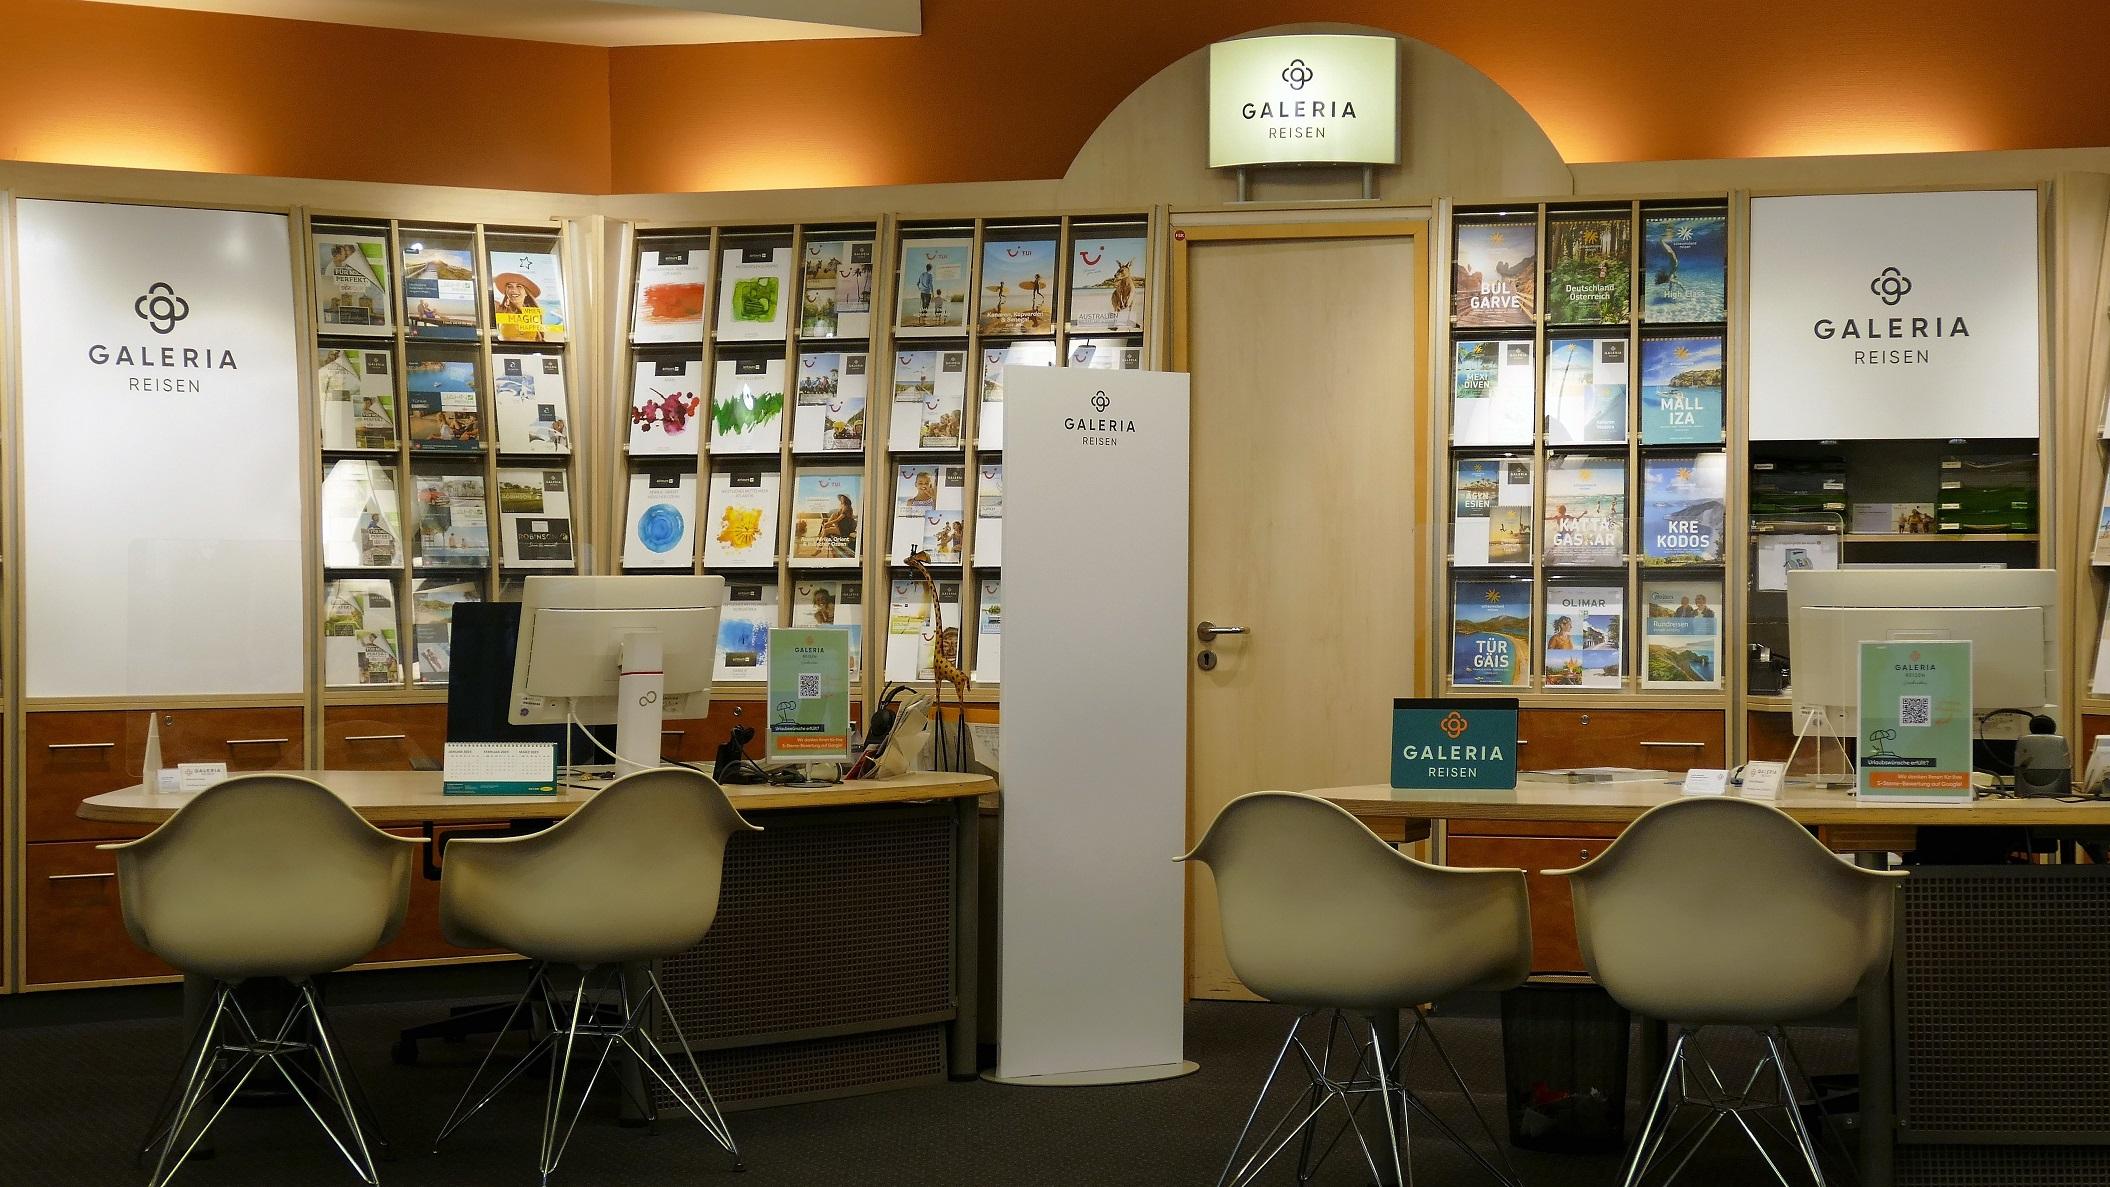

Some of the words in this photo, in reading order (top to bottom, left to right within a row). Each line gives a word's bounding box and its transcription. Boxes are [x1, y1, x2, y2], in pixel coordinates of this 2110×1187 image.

[1242, 100, 1357, 120] GALERIA
[1269, 126, 1326, 139] REISEN
[1481, 281, 1511, 295] BUL
[1565, 284, 1615, 293] Deutschland
[1663, 290, 1681, 300] High
[1470, 296, 1521, 309] GARVE
[1079, 312, 1119, 320] AUSTRALIEN
[1813, 316, 1970, 340] GALERIA
[88, 344, 238, 370] GALERIA
[1854, 350, 1929, 365] REISEN
[1466, 373, 1488, 381] MEXI
[129, 377, 200, 393] REISEN
[1464, 381, 1490, 389] DIVEN
[1661, 397, 1704, 411] MALL
[1669, 411, 1695, 425] IZA
[1064, 417, 1136, 433] GALERIA
[1082, 436, 1117, 446] REISEN
[1464, 500, 1490, 508] ESIEN
[1668, 520, 1699, 534] KRE
[1657, 535, 1710, 548] KODOS
[1562, 599, 1606, 608] OLIMAR
[1653, 620, 1689, 628] Rundreisen
[1475, 637, 1508, 654] TÜR
[1473, 653, 1509, 668] GÄIS
[1403, 745, 1504, 761] GALERIA
[1428, 767, 1478, 778] REISEN
